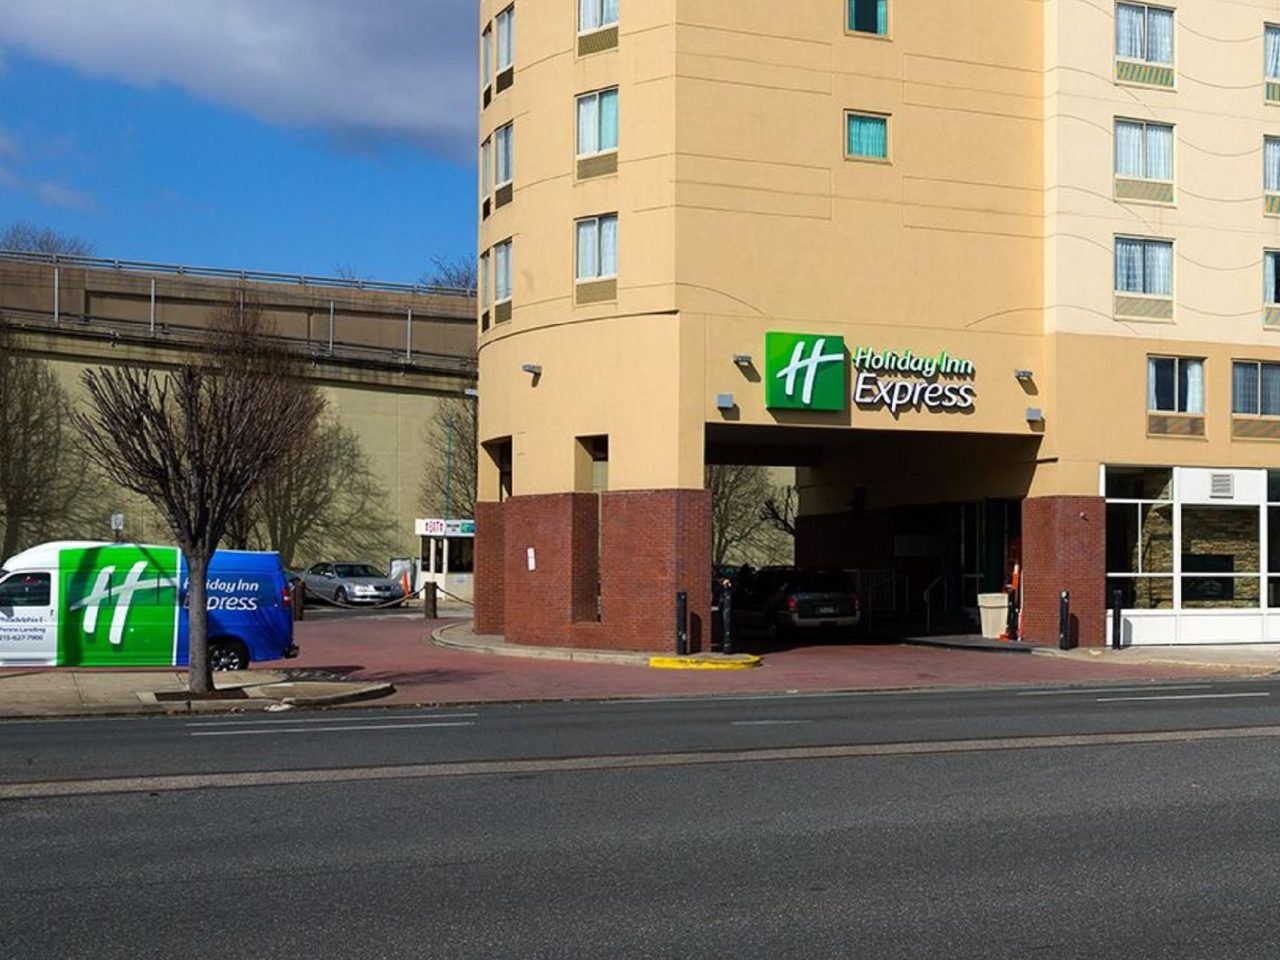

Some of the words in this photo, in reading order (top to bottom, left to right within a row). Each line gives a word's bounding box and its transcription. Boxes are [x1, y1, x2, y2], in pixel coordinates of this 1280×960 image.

[854, 346, 937, 377] Holiday
[938, 350, 974, 375] Inn
[854, 371, 976, 413] Express
[237, 578, 259, 591] Inn
